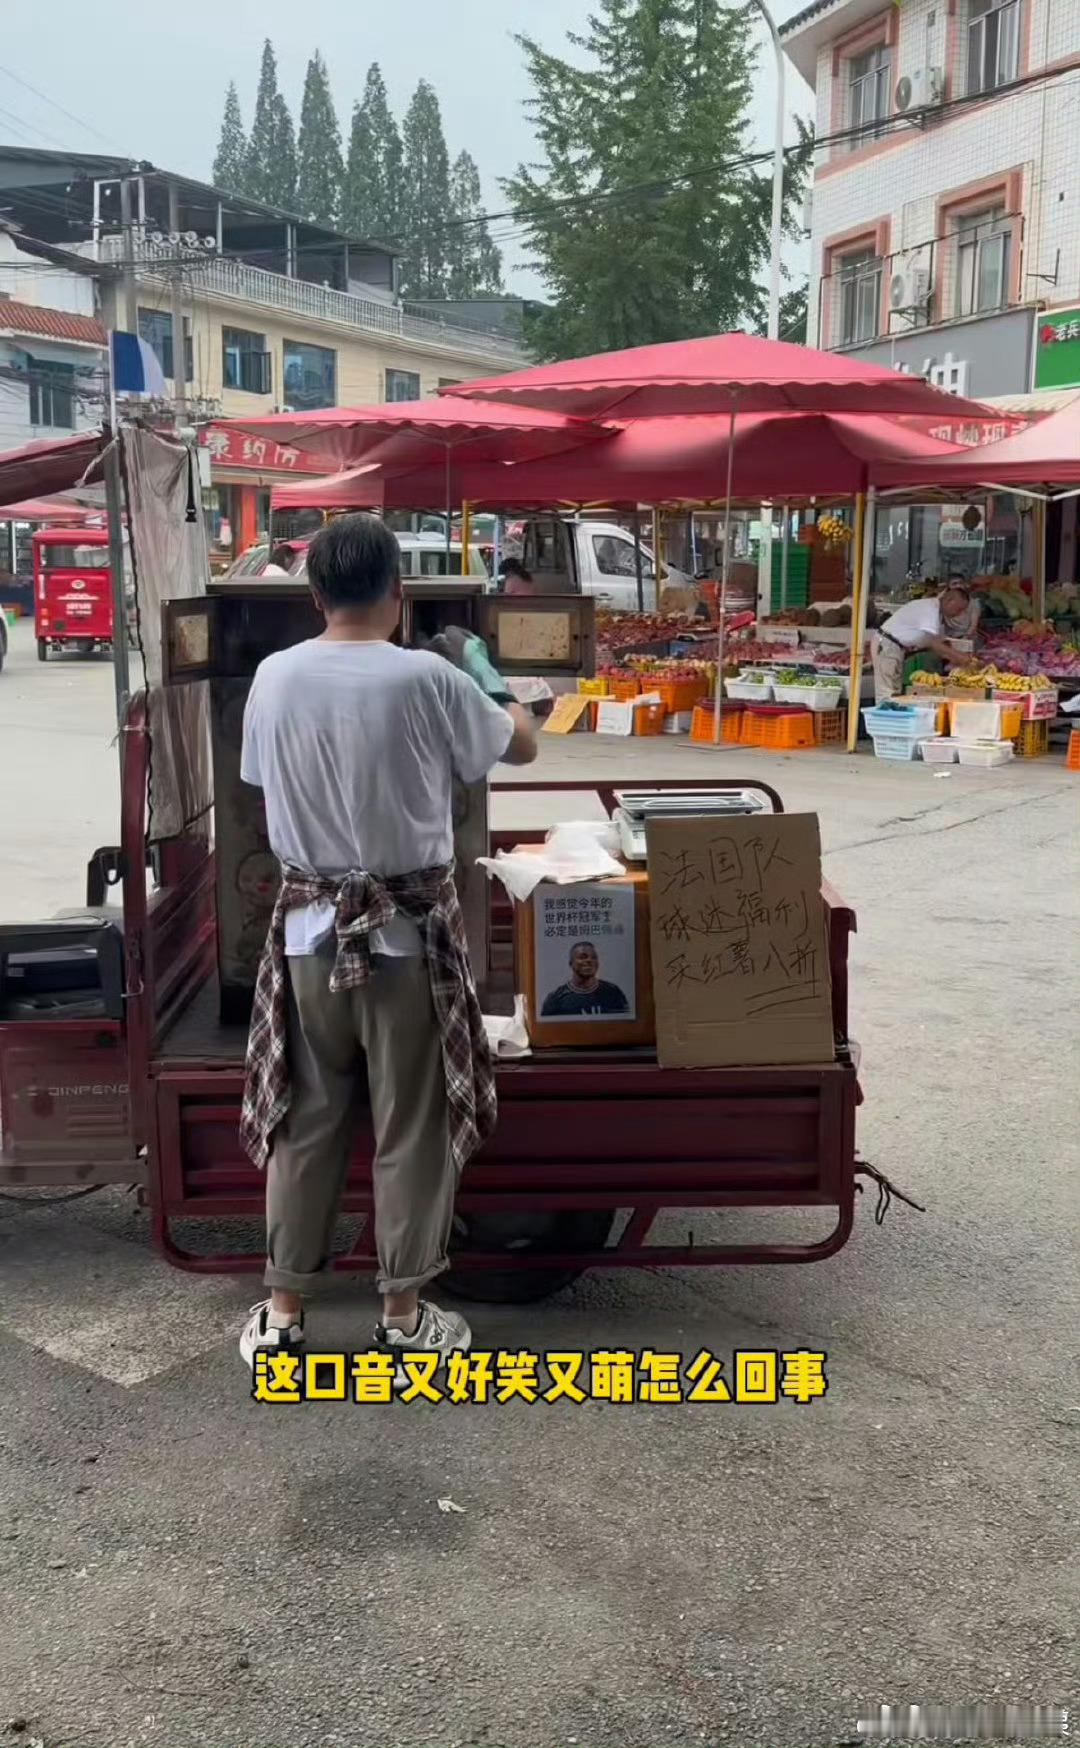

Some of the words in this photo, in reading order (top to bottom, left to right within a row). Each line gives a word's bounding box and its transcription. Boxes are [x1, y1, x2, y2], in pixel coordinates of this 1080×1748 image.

[660, 836, 795, 894] 法国队
[543, 896, 613, 910] 我感觉今年的
[656, 888, 812, 942] 球迷福利
[665, 938, 820, 998] 买红薯八折
[47, 1083, 130, 1097] JINPENG
